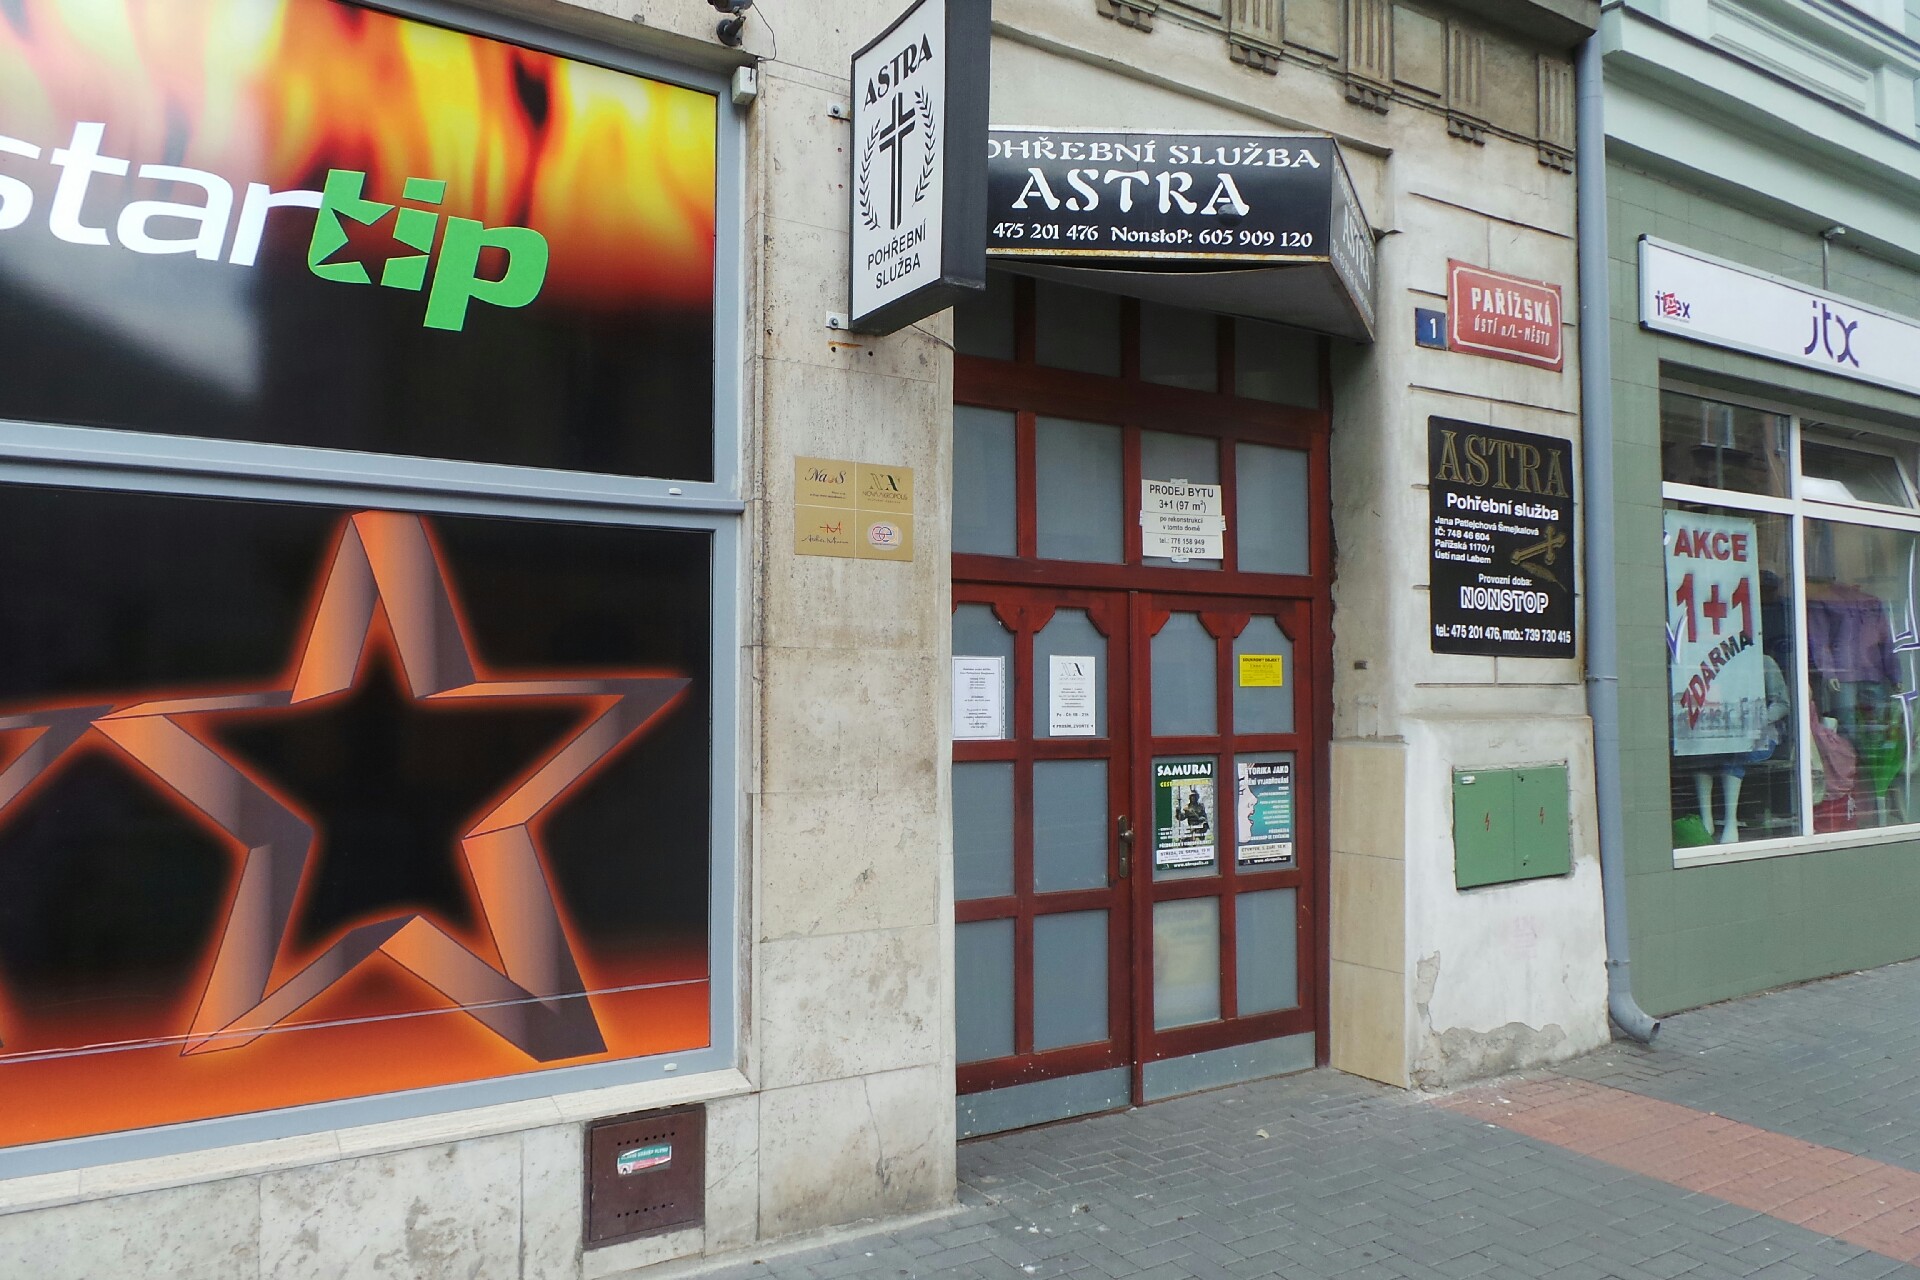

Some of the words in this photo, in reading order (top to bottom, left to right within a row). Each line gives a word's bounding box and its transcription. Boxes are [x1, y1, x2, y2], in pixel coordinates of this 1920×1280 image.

[863, 32, 933, 111] ASTRA
[1168, 142, 1321, 169] SLUŽBA
[1011, 167, 1250, 217] ASTRA
[867, 218, 927, 271] POHŘEBNÍ
[992, 222, 1024, 238] 475
[1029, 223, 1060, 240] 201
[1066, 224, 1099, 241] 476
[1198, 229, 1233, 245] 605
[1239, 230, 1276, 247] 909
[1279, 231, 1313, 248] 120
[875, 252, 921, 290] SLUŽBA
[1471, 287, 1552, 326] PAŘÍŽSKÁ
[1430, 318, 1437, 339] 1
[1474, 314, 1498, 333] ÚSTÍ
[1435, 429, 1569, 498] ASTRA
[1149, 484, 1185, 496] PRODEJ
[1188, 487, 1214, 498] BYTU
[1159, 499, 1173, 509] 3+1
[1176, 500, 1189, 512] (97
[1446, 492, 1512, 515] Pohřební
[1514, 503, 1559, 521] služba
[1435, 515, 1454, 526] Jana
[1435, 526, 1446, 537] IČ:
[1447, 529, 1462, 539] 748
[1463, 531, 1474, 540] 46
[1475, 532, 1490, 541] 604
[1435, 538, 1467, 550] Pařížská
[1469, 542, 1495, 554] 1170/1
[1435, 549, 1451, 560] Ústí
[1451, 553, 1466, 562] nad
[1466, 554, 1492, 564] Labem
[1673, 528, 1748, 562] AKCE
[1478, 573, 1511, 585] Provozní
[1511, 576, 1533, 586] doba:
[1460, 585, 1549, 614] NONSTOP
[1676, 573, 1754, 646] 1+1
[1451, 624, 1467, 638] 475
[1468, 625, 1483, 639] 201
[1524, 628, 1541, 642] 739
[1541, 629, 1556, 642] 730
[1557, 630, 1571, 643] 415
[1680, 629, 1754, 730] ZDARMA
[1157, 763, 1211, 777] SAMURAJ
[1242, 766, 1272, 776] ETORIKA
[1272, 765, 1289, 774] JAKO
